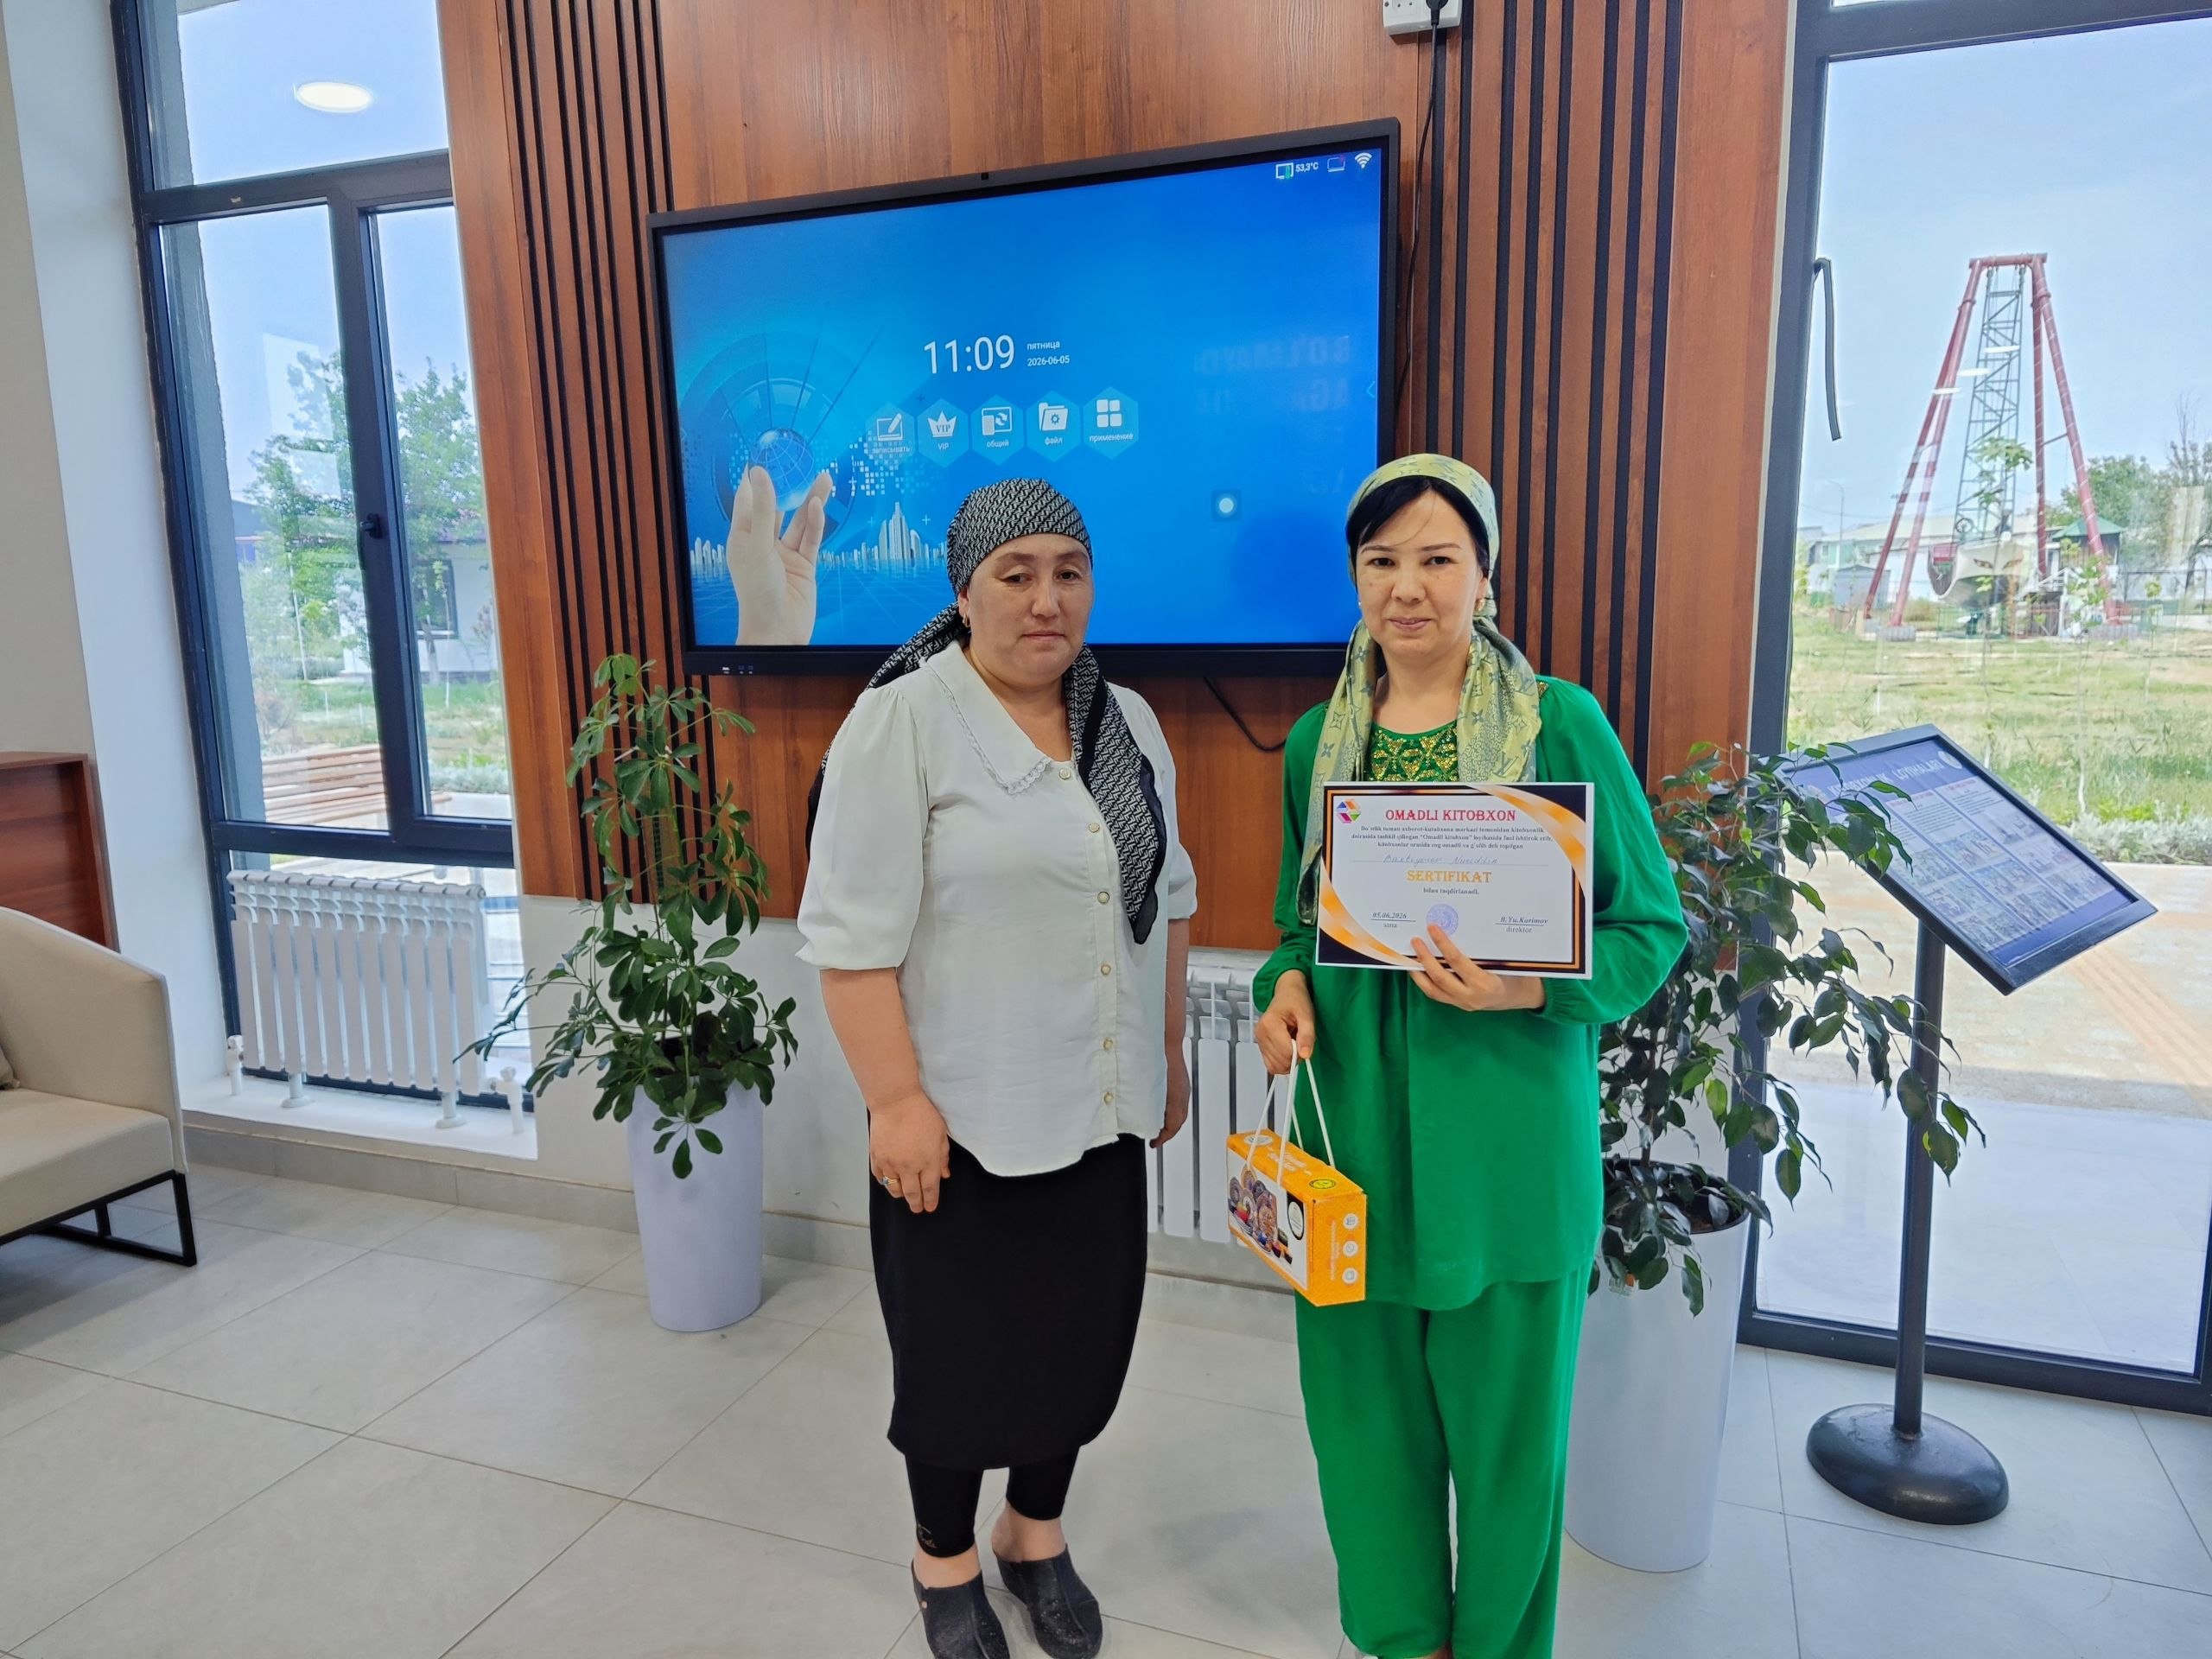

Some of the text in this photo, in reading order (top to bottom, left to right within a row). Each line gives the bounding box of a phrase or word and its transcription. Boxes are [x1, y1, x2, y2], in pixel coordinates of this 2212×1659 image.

[1027, 340, 1061, 351] пятница
[924, 334, 1015, 374] 11:09
[1027, 355, 1070, 367] 2026-06-05
[936, 424, 950, 433] VIP
[1044, 436, 1063, 446] файл
[1090, 432, 1134, 443] применение
[938, 442, 950, 450] VIP
[986, 439, 1009, 448] общий
[1385, 809, 1516, 822] OMADLI KITOBXON
[1407, 870, 1492, 883] SERTIFIKAT
